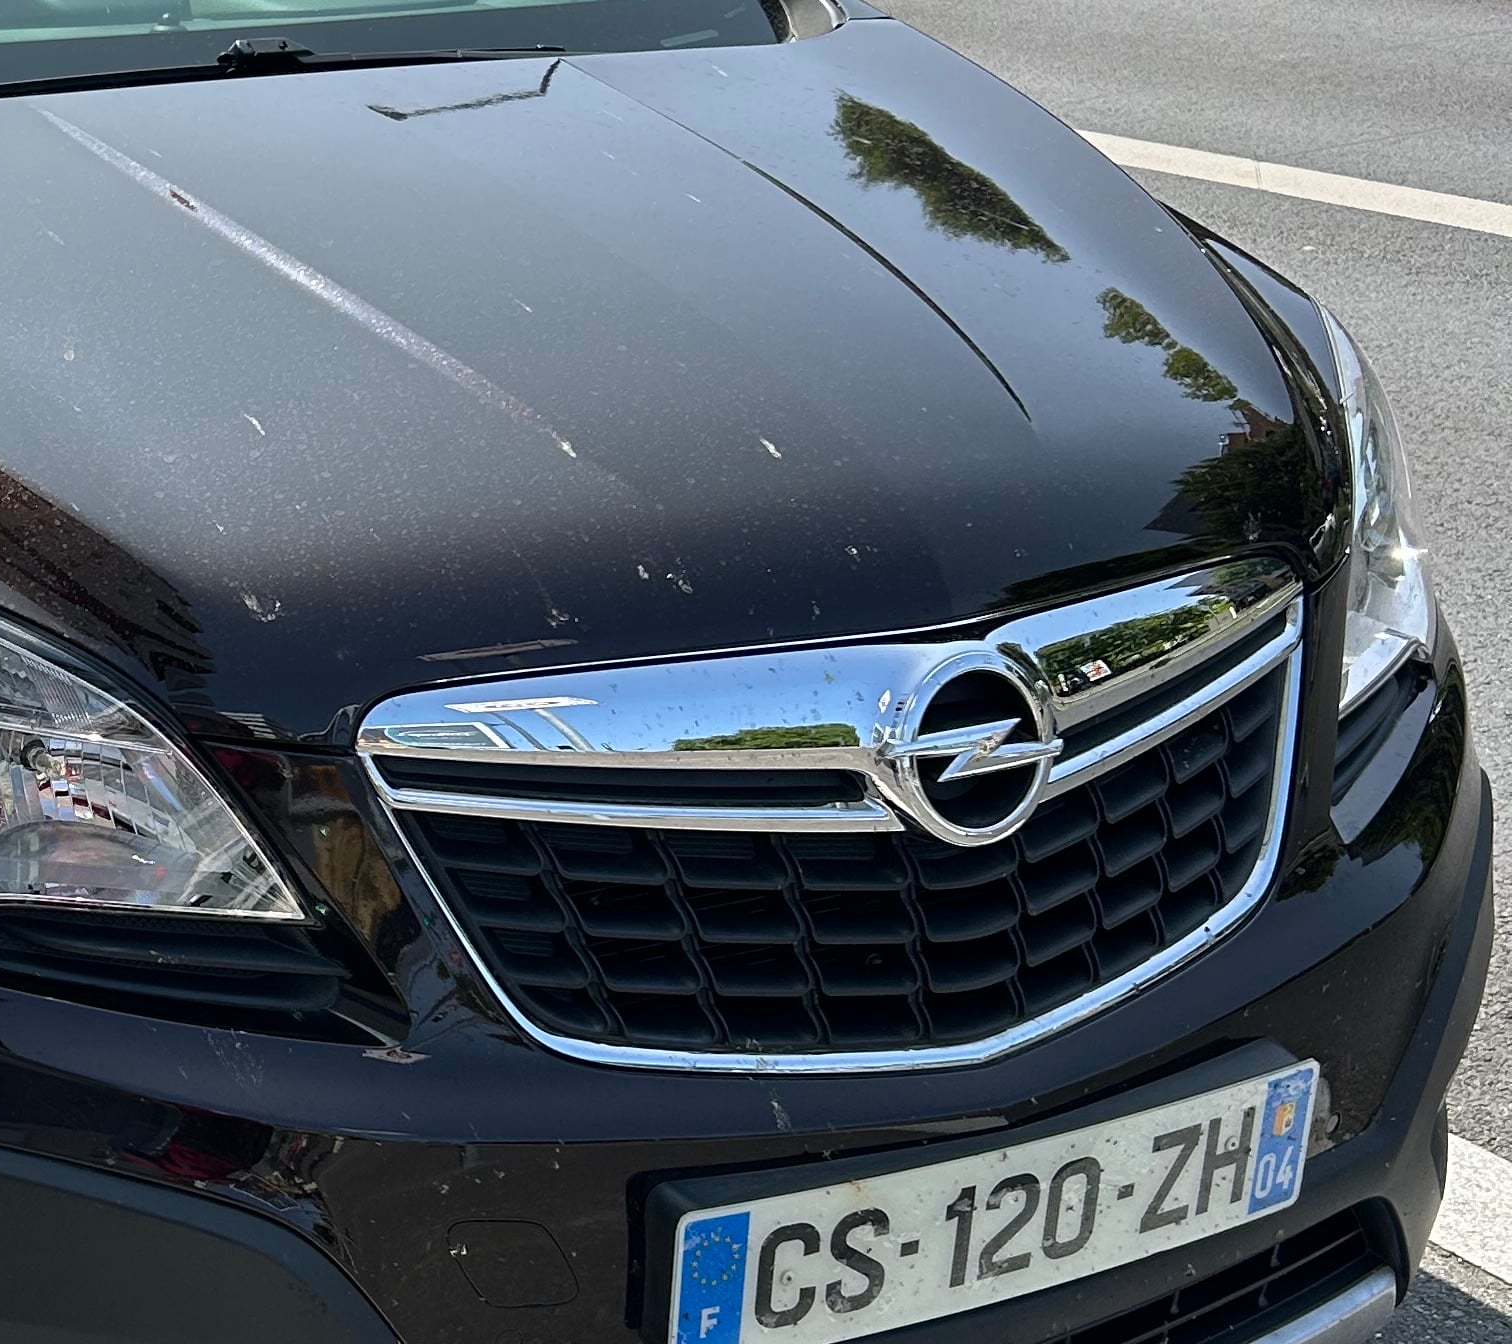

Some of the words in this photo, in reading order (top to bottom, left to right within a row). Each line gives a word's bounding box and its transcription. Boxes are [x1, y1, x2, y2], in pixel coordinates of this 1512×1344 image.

[1255, 1145, 1294, 1199] 04
[754, 1106, 1256, 1330] CS-120-ZH
[698, 1305, 721, 1340] F
